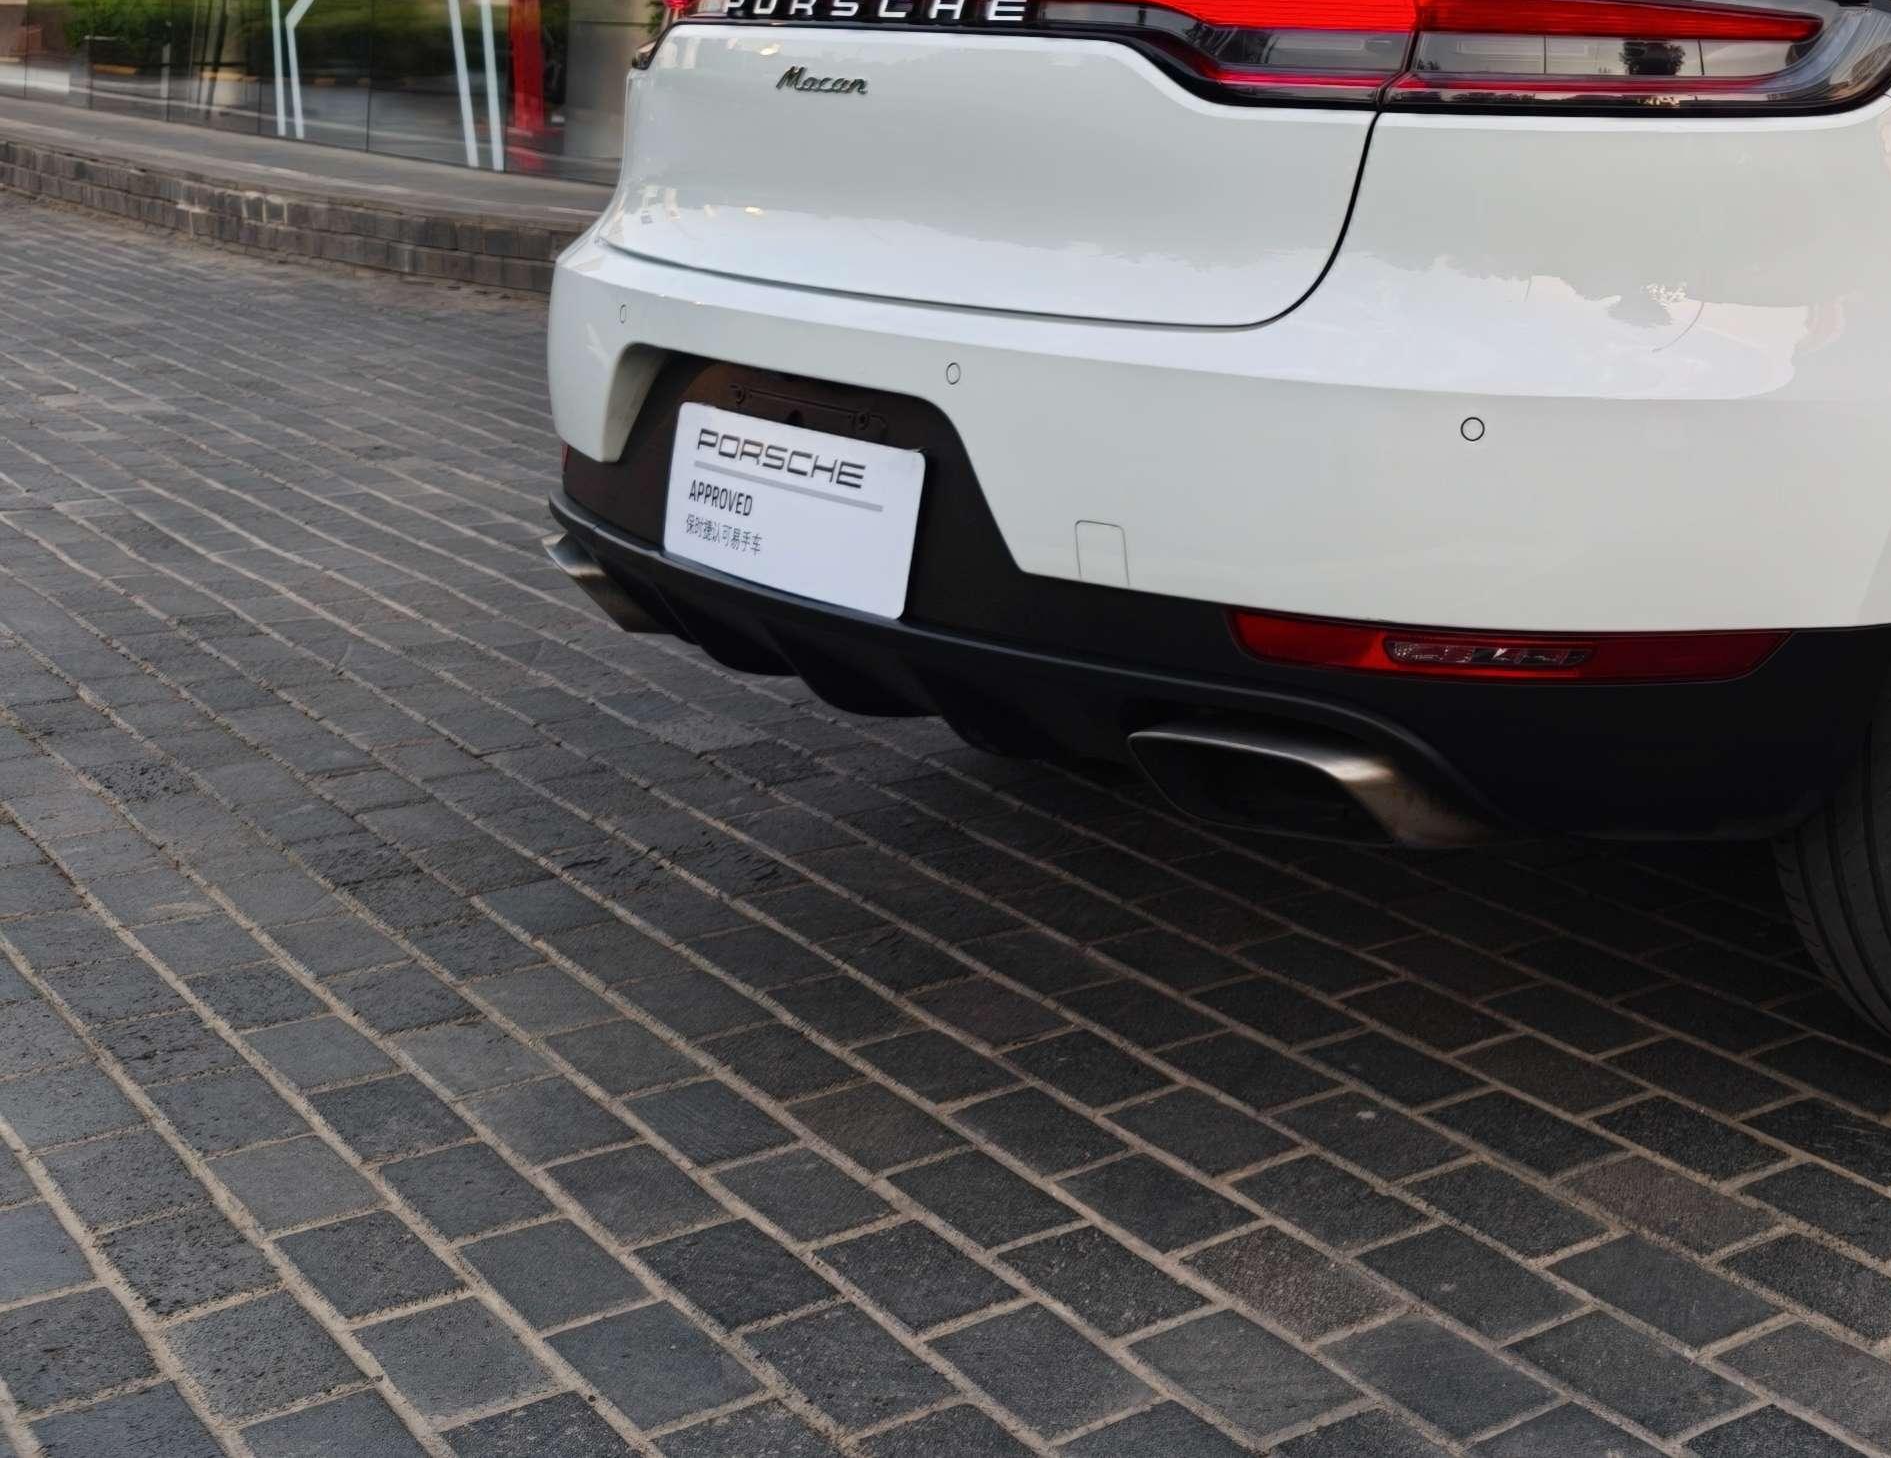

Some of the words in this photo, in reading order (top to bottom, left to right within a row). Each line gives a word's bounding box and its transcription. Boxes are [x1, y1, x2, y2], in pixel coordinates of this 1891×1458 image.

[775, 65, 869, 95] Macan
[697, 428, 866, 489] PORSCHE
[688, 480, 753, 517] APPROVED
